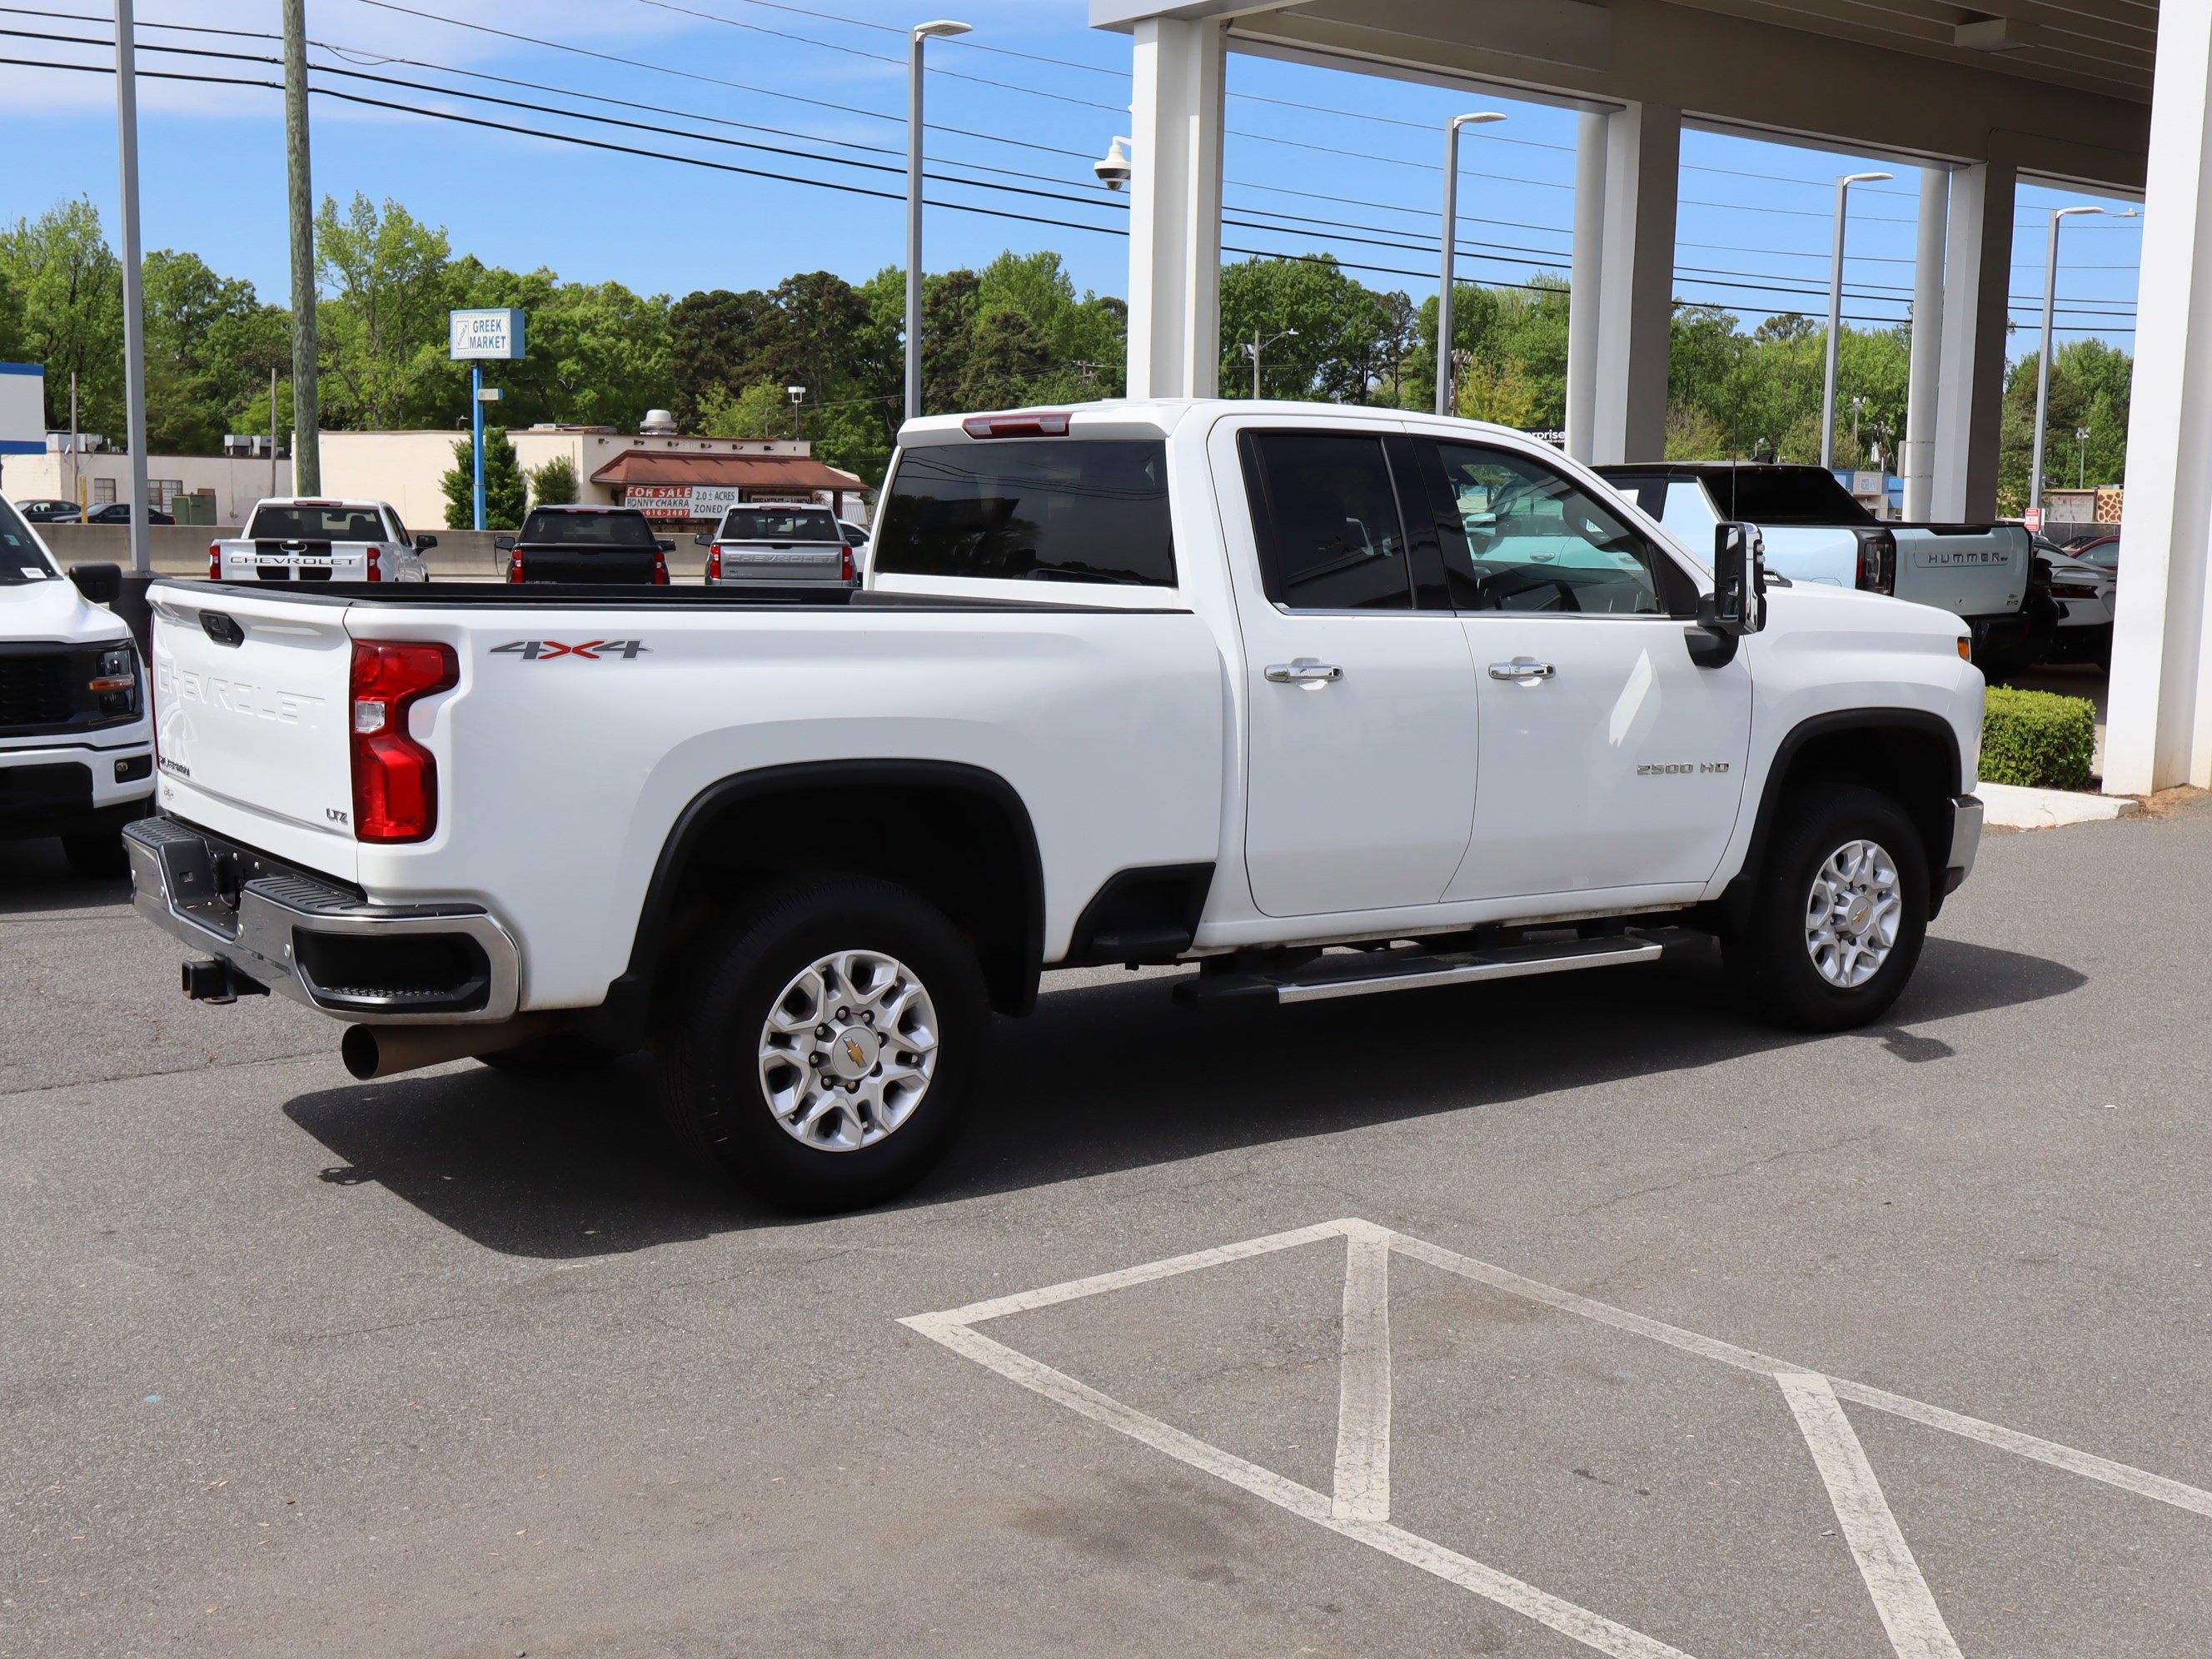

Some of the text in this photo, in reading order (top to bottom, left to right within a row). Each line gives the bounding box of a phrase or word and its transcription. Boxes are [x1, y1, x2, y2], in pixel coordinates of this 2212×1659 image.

[472, 319, 502, 333] GREEK
[469, 336, 506, 349] MARKET
[626, 486, 692, 498] FOR SALE
[695, 491, 707, 501] 2.0
[714, 491, 735, 501] ACRES
[655, 499, 690, 508] CHAKRA
[694, 504, 723, 513] ZONED
[642, 508, 690, 516] -616-2487
[230, 556, 356, 565] CHEVROLET
[1927, 552, 2000, 564] HUMMER
[158, 663, 326, 730] CHEVROLET
[1637, 761, 1730, 775] 2500 HD
[326, 808, 348, 825] LTZ
